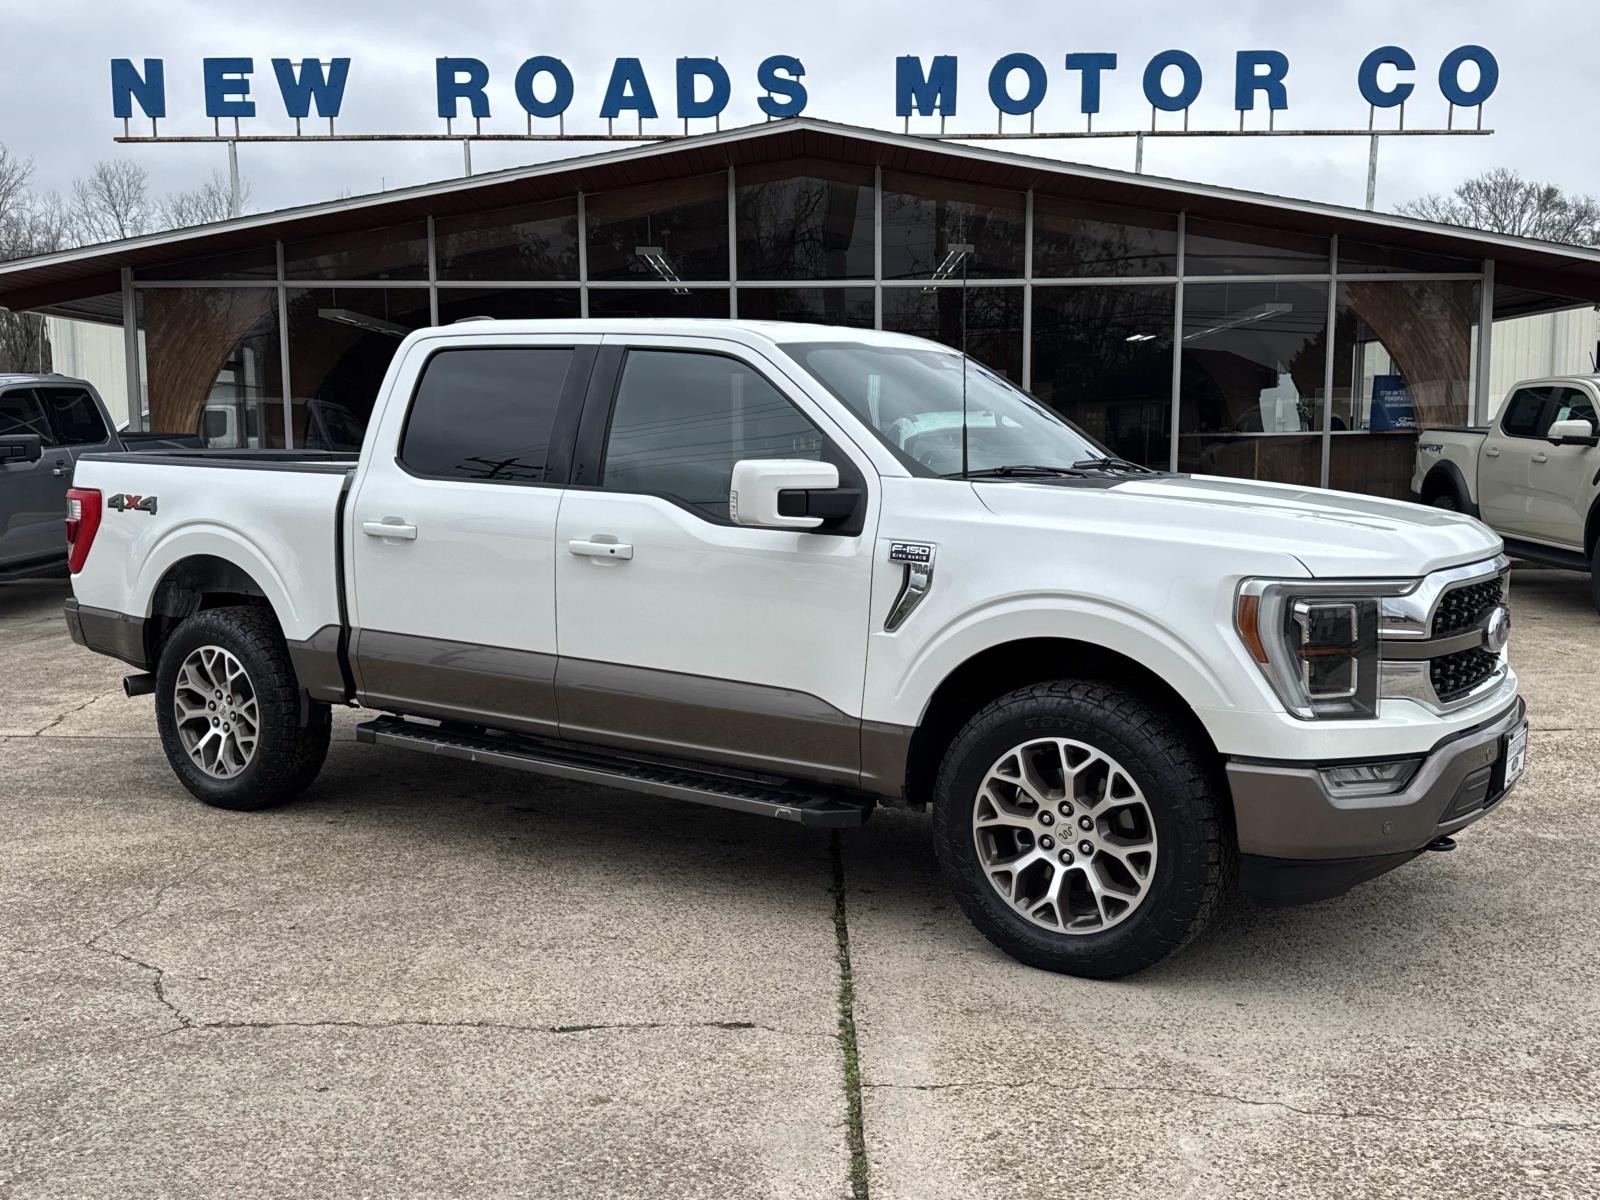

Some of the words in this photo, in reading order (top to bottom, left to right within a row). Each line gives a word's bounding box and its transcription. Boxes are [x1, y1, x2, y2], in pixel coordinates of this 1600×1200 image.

[111, 57, 351, 119] NEW
[436, 55, 808, 119] ROADS
[896, 49, 1289, 117] MOTOR
[1358, 44, 1499, 108] CO
[892, 545, 930, 555] F-150
